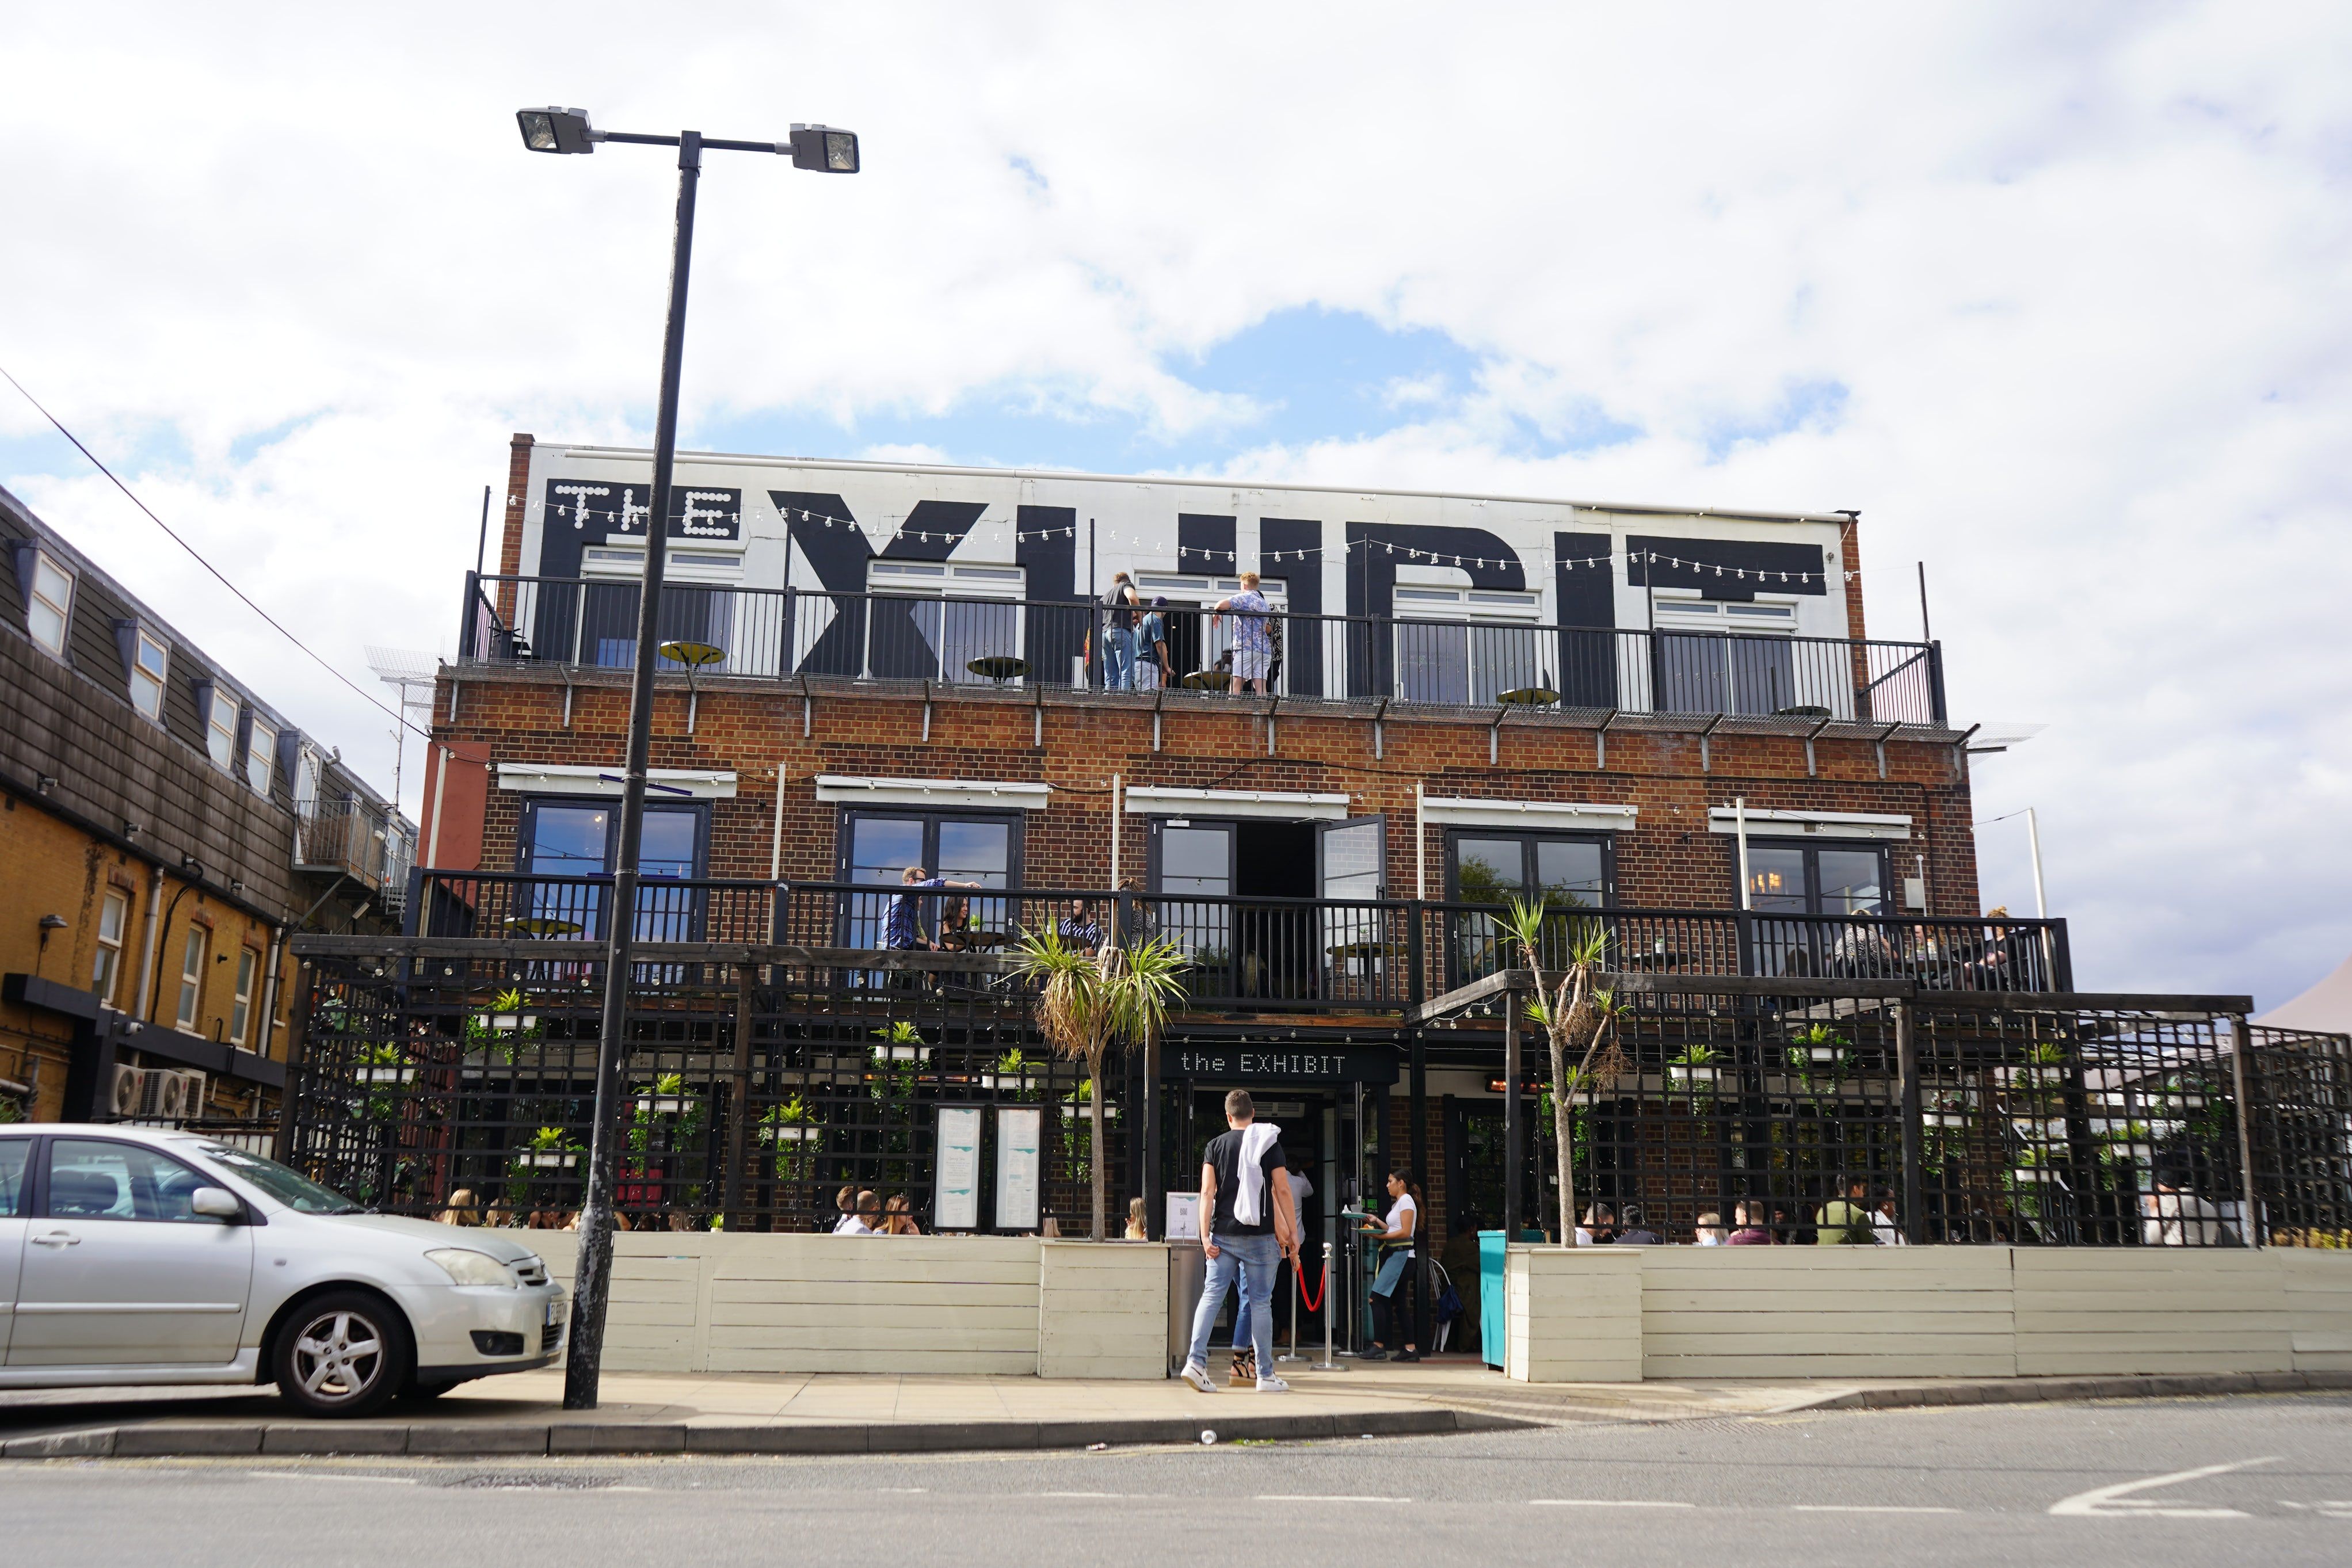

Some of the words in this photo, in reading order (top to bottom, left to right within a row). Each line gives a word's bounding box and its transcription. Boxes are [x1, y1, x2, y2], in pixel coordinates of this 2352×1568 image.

[555, 484, 731, 537] THE
[1181, 1052, 1225, 1071] the
[1241, 1054, 1345, 1074] EXHIBIT
